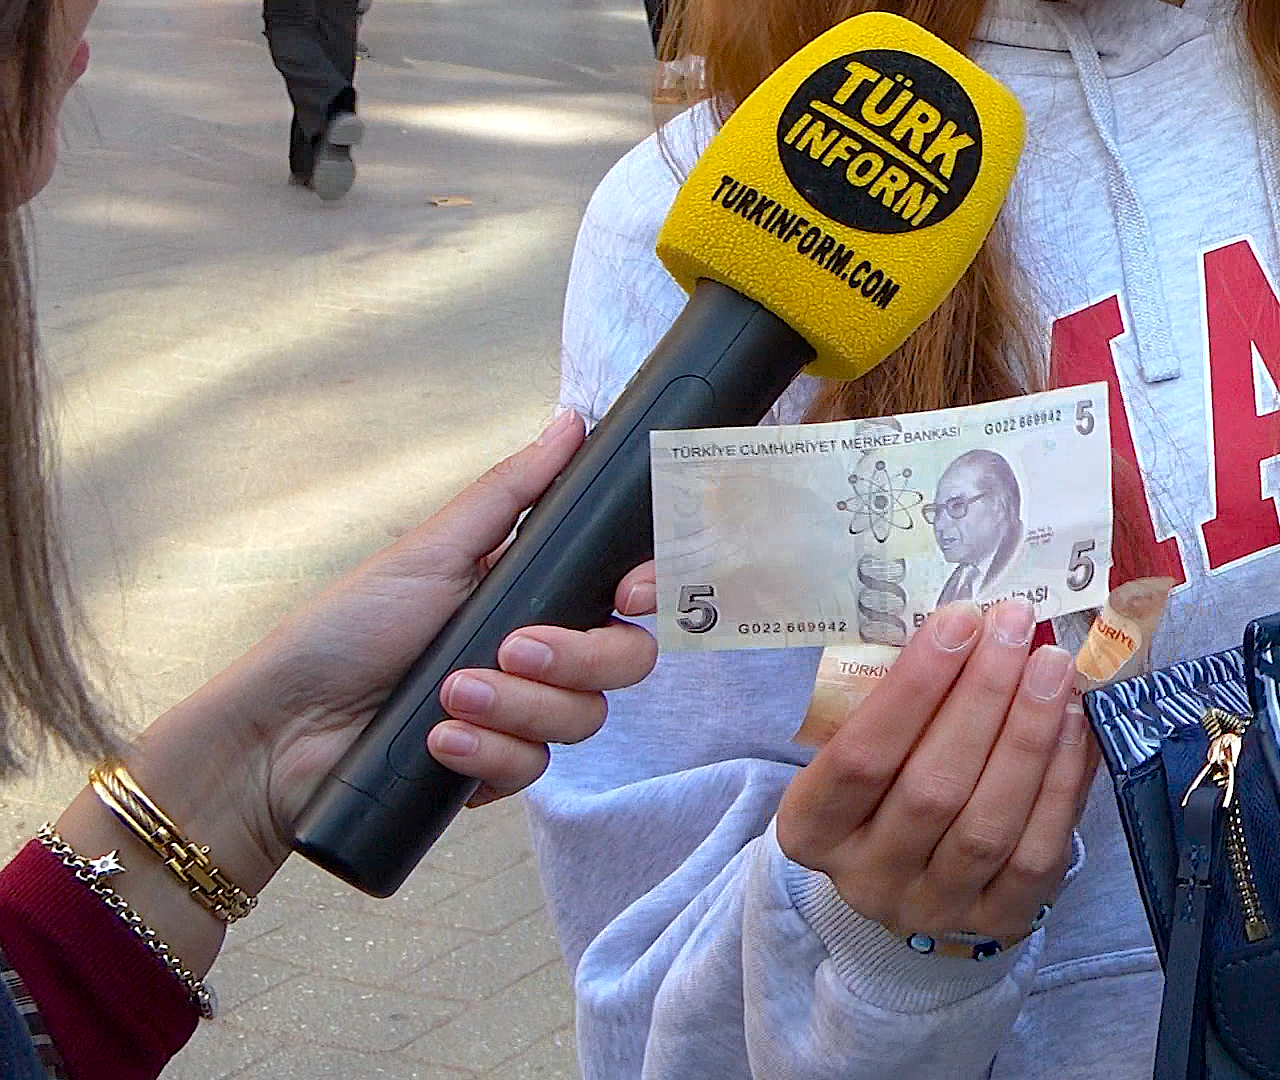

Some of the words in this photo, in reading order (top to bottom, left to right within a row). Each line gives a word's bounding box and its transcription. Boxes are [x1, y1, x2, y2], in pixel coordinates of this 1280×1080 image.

[833, 61, 975, 181] TÜRK
[784, 113, 939, 227] INFORM
[711, 174, 900, 310] TURKINFORM.COM
[672, 442, 737, 459] TÜRKİYE
[841, 432, 901, 451] MERKEZ
[903, 426, 961, 444] BANKASI
[1075, 399, 1095, 436] 5
[1067, 538, 1096, 592] 5
[676, 583, 719, 634] 5
[838, 661, 888, 678] TÜRKİ
